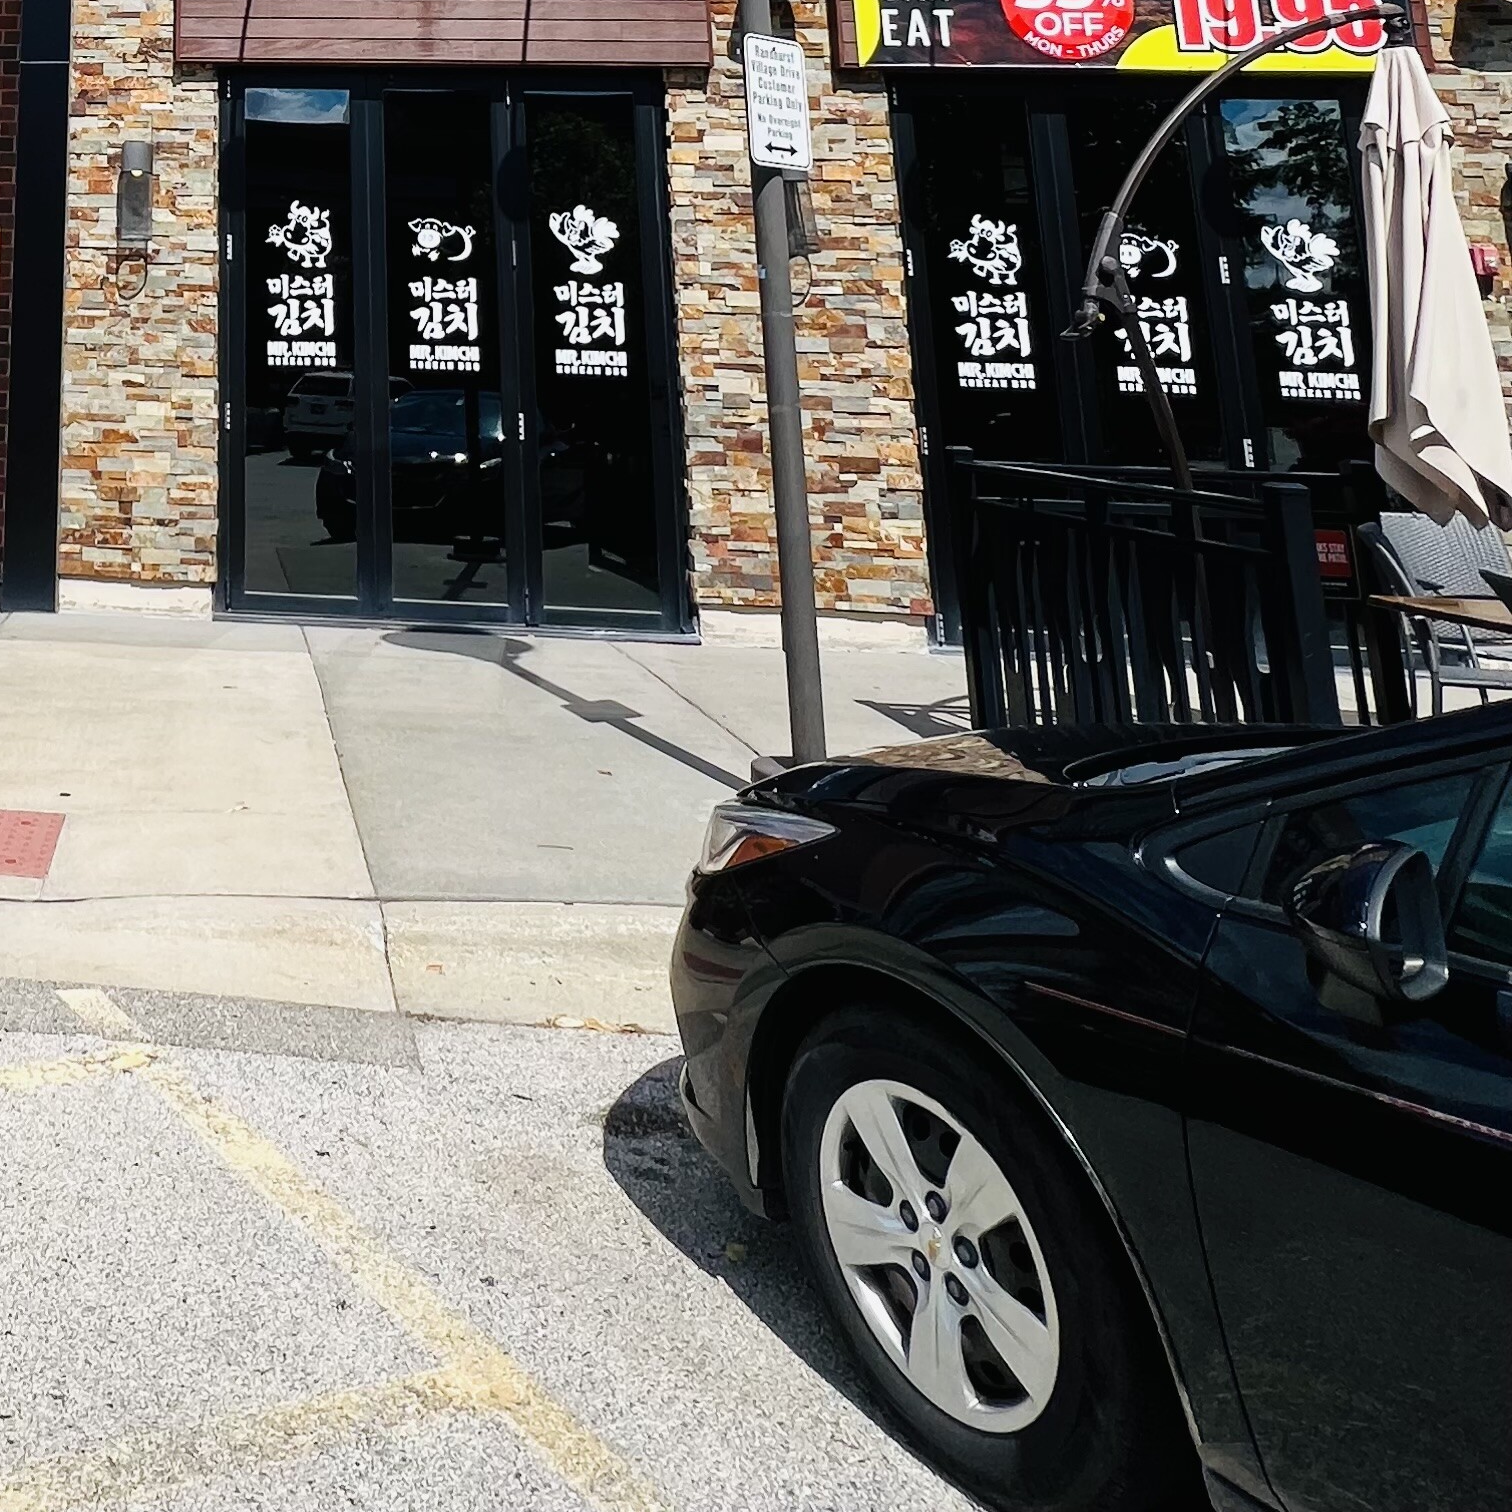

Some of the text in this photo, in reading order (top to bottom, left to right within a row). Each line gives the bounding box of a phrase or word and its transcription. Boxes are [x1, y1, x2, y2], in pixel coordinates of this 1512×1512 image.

[881, 8, 954, 47] EAT
[1034, 11, 1104, 36] OFF
[1023, 30, 1062, 57] MON
[1076, 25, 1125, 57] THURS
[758, 76, 795, 94] Customer
[752, 91, 802, 112] Parking Only
[768, 127, 793, 141] Parking
[266, 273, 334, 299] 미스터
[408, 276, 477, 302] 미스터
[553, 280, 624, 307] 미스터
[267, 298, 334, 336] 김치
[950, 291, 1027, 318] 미스터
[1270, 298, 1349, 327] 미스터
[409, 301, 478, 341] 김치
[555, 306, 625, 346] 김치
[955, 317, 1031, 357] 김치
[1275, 326, 1355, 367] 김치
